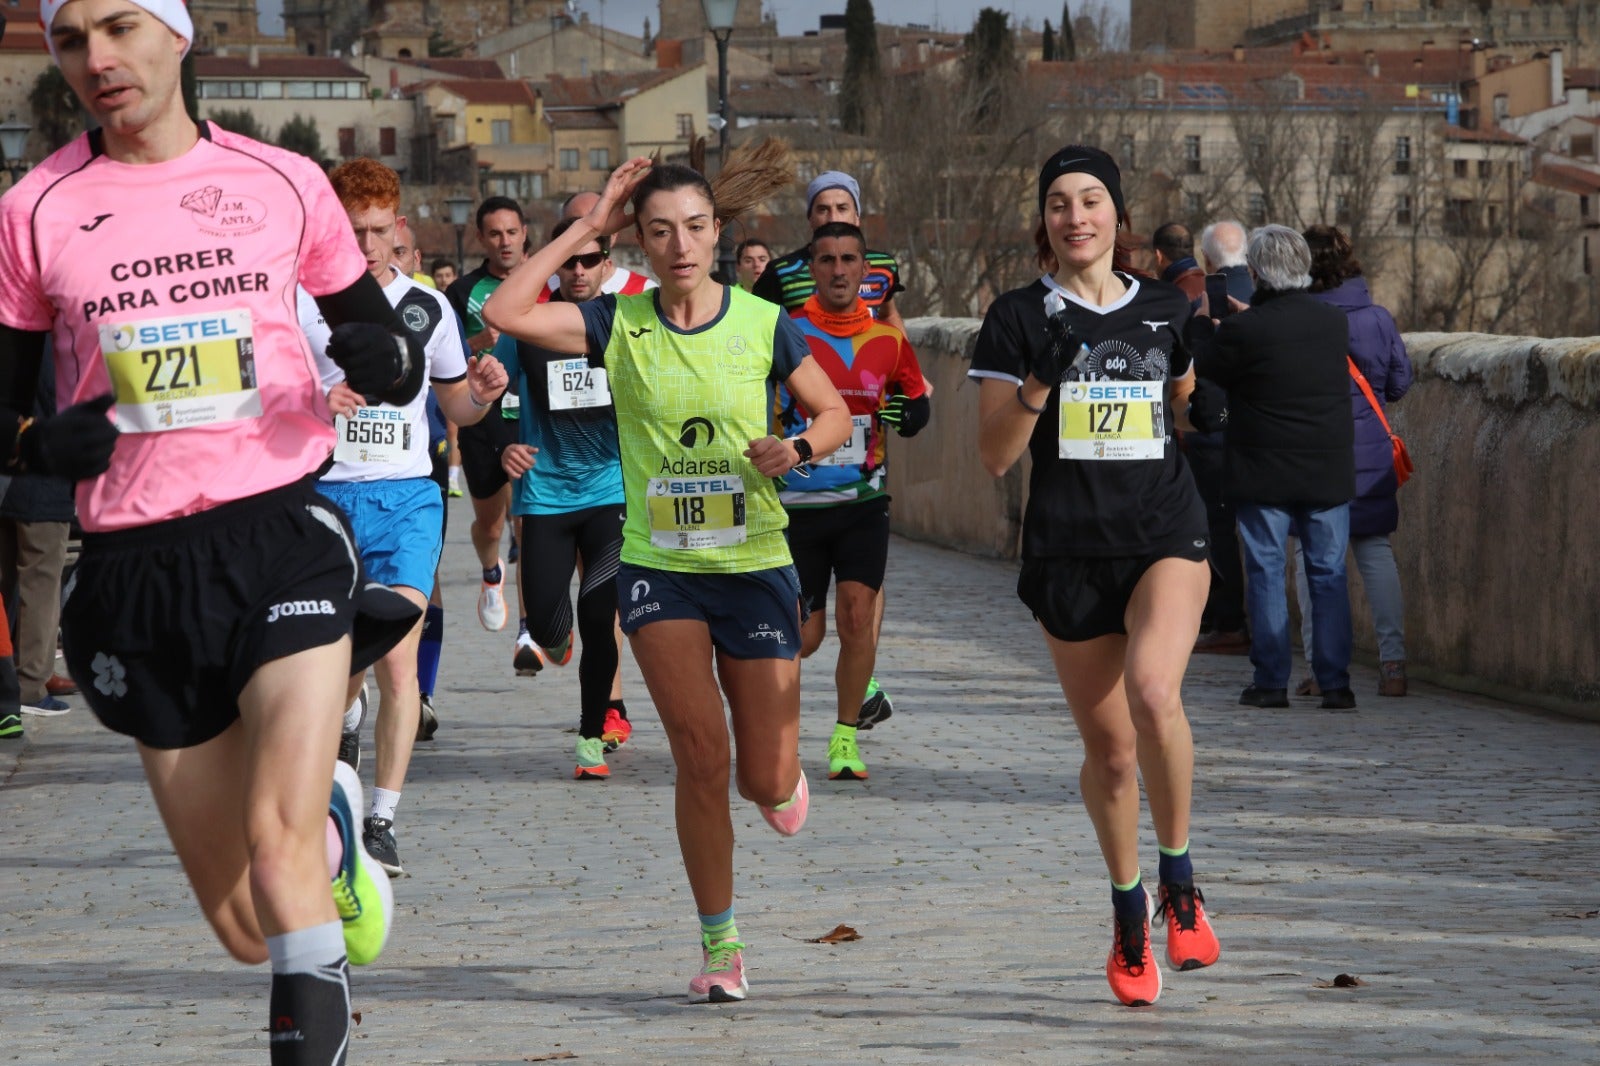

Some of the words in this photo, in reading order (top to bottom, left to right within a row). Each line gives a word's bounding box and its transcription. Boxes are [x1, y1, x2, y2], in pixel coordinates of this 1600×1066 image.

[220, 216, 254, 225] ANTA
[110, 248, 235, 282] CORRER
[83, 289, 159, 321] PARA
[169, 272, 269, 303] COMER
[139, 318, 238, 344] SETEL
[141, 345, 202, 392] 221
[1105, 356, 1127, 372] edp
[562, 371, 594, 392] 624
[1089, 386, 1153, 399] SETEL
[358, 409, 405, 421] SETEL
[1088, 403, 1128, 433] 127
[346, 420, 395, 444] 6563
[660, 456, 731, 475] Adarsa
[670, 480, 734, 494] SETEL
[673, 496, 705, 525] 118
